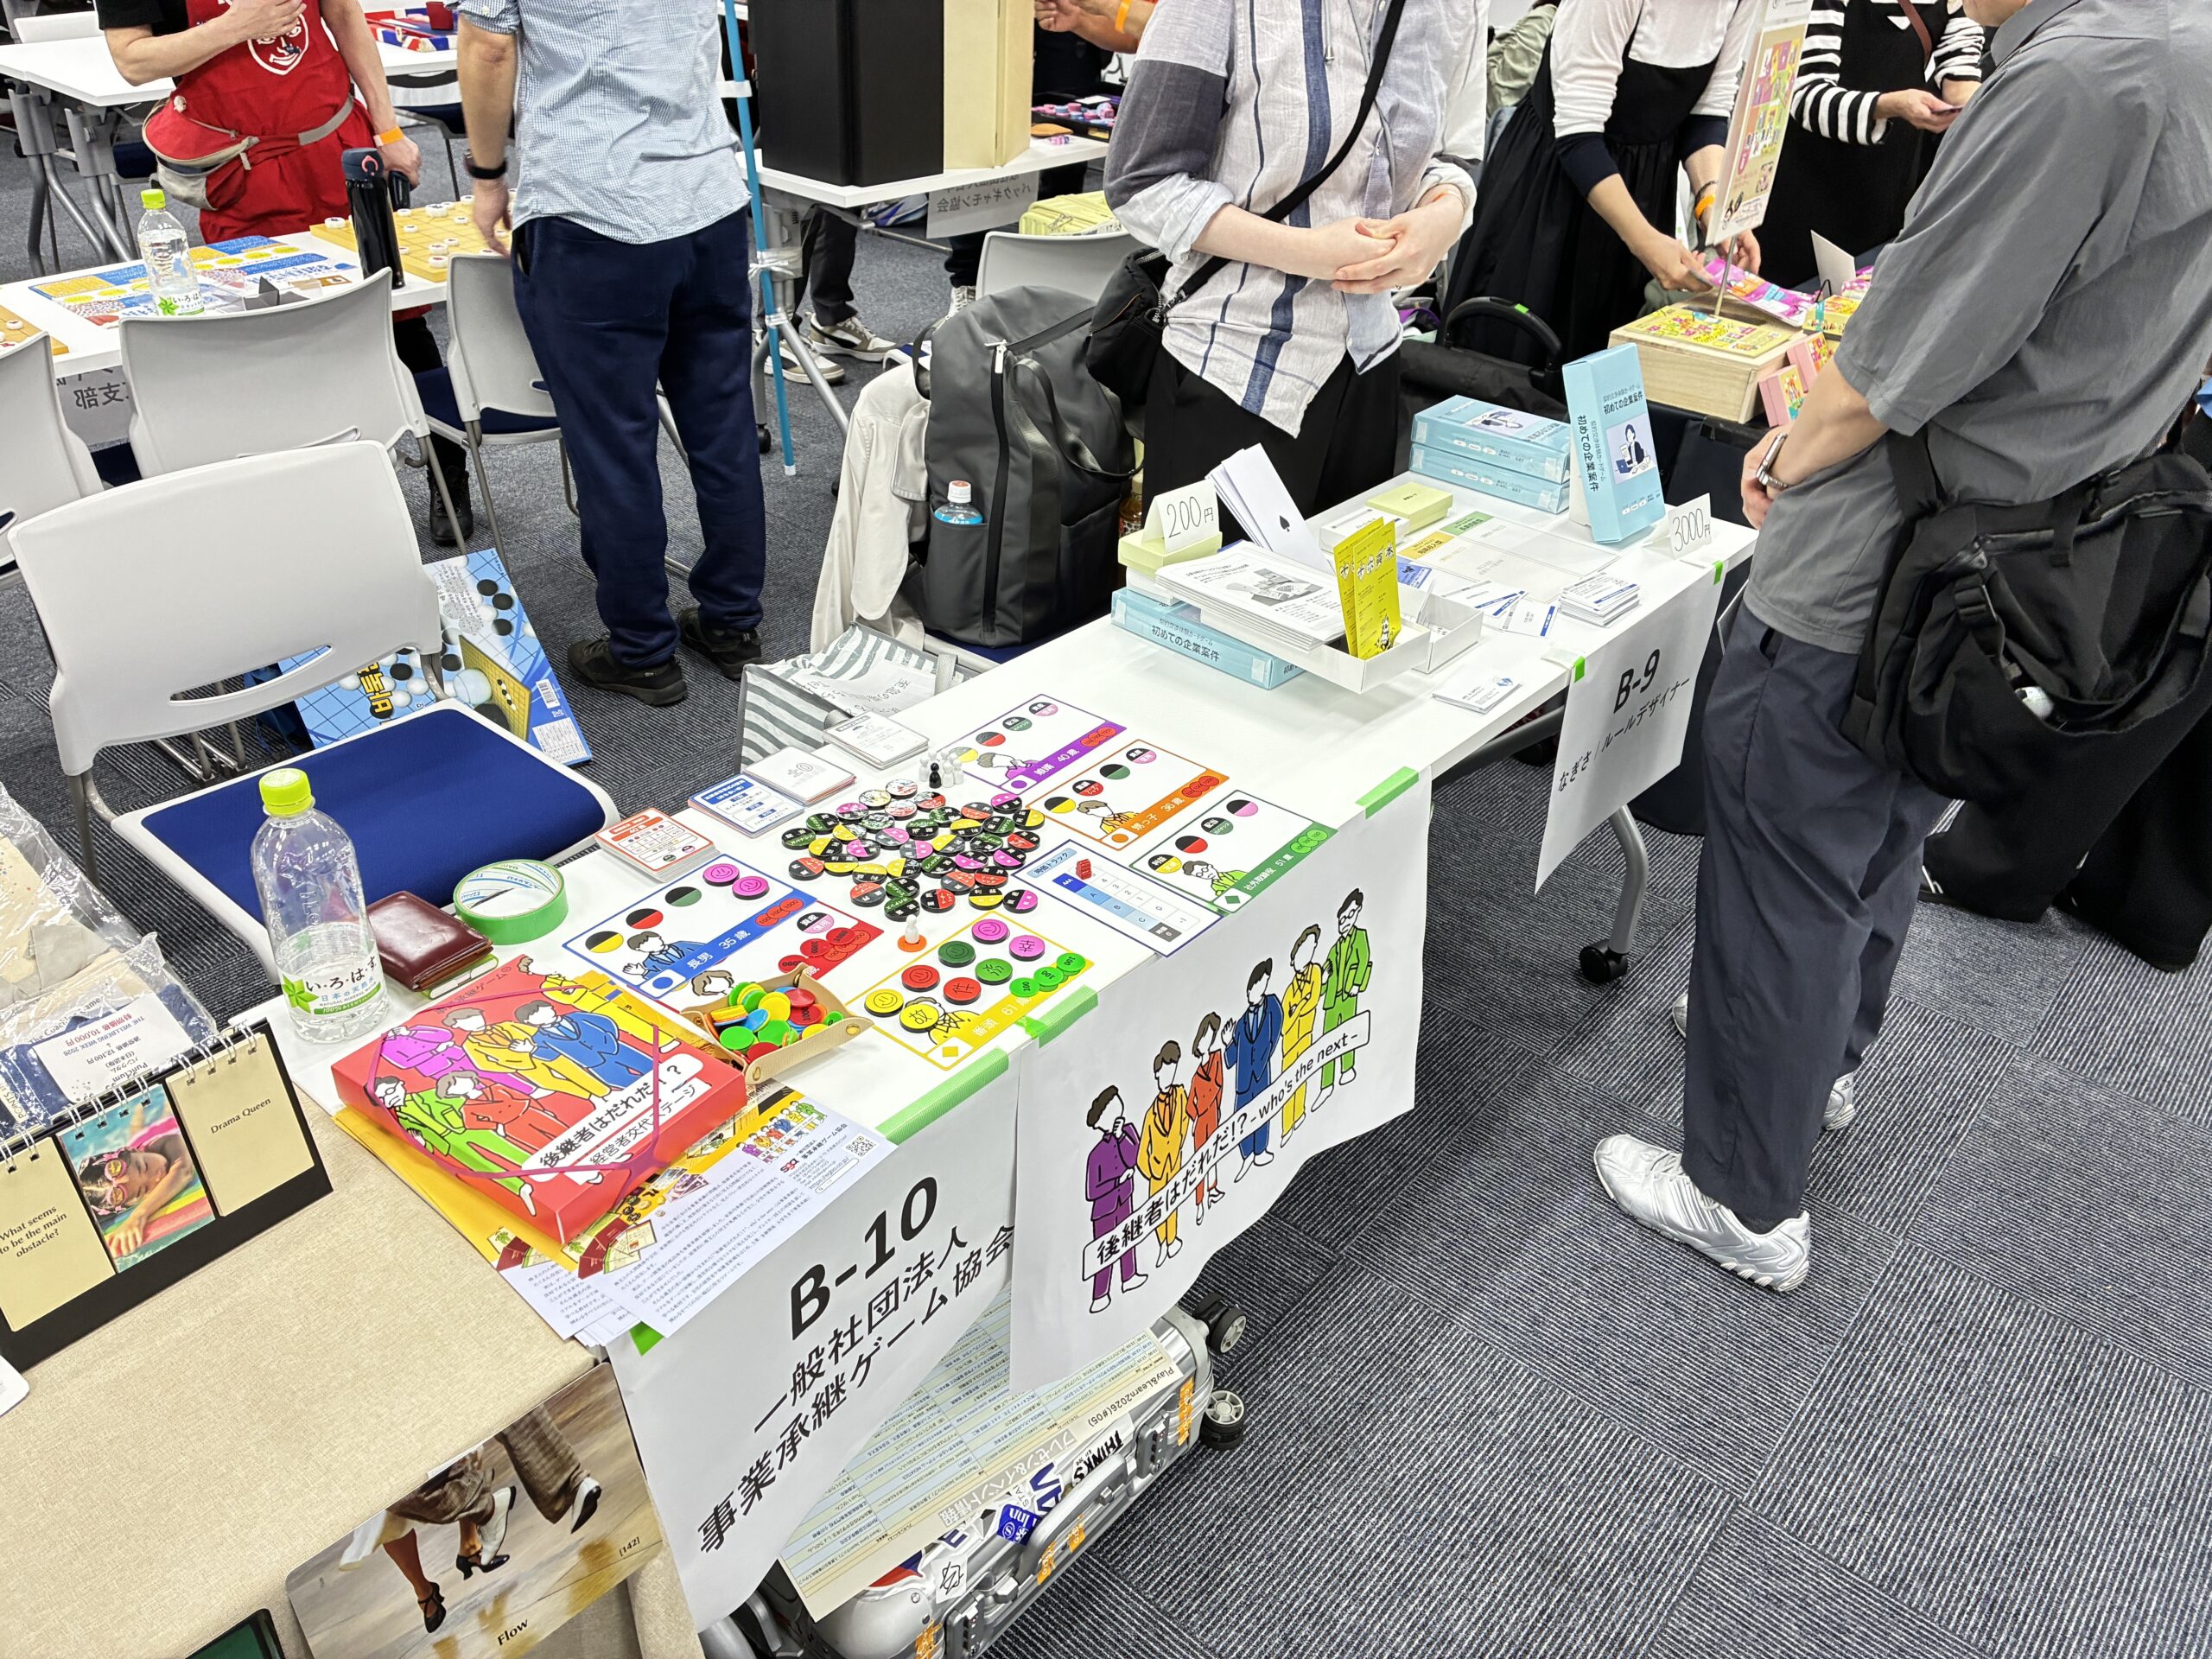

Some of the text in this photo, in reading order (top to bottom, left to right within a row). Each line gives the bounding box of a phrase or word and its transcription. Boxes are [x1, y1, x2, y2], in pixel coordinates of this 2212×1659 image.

[1603, 391, 1643, 416] 初めての企業案件
[1577, 415, 1599, 492] 初めての企業案件
[1166, 496, 1215, 539] 200円
[1672, 508, 1711, 552] 3000円
[1151, 625, 1220, 662] 初めての企業案件
[1613, 648, 1661, 715] B-9
[687, 952, 714, 969] 長男
[1294, 1060, 1314, 1084] the
[210, 1097, 271, 1135] Drama Queen
[0, 1206, 57, 1241] What seems
[10, 1237, 23, 1248] be
[25, 1227, 41, 1240] the
[42, 1213, 67, 1230] main
[16, 1228, 59, 1257] obstacle?
[790, 1176, 938, 1341] B-10
[753, 1224, 969, 1434] 一般社団法人
[696, 1223, 1015, 1555] 事業承継ゲーム協会
[1085, 1365, 1175, 1427] Play&Learn2026(#05)
[939, 1430, 1077, 1527] プレゼン&イベント情報
[618, 1535, 641, 1557] [142]
[496, 1617, 529, 1647] Flow
